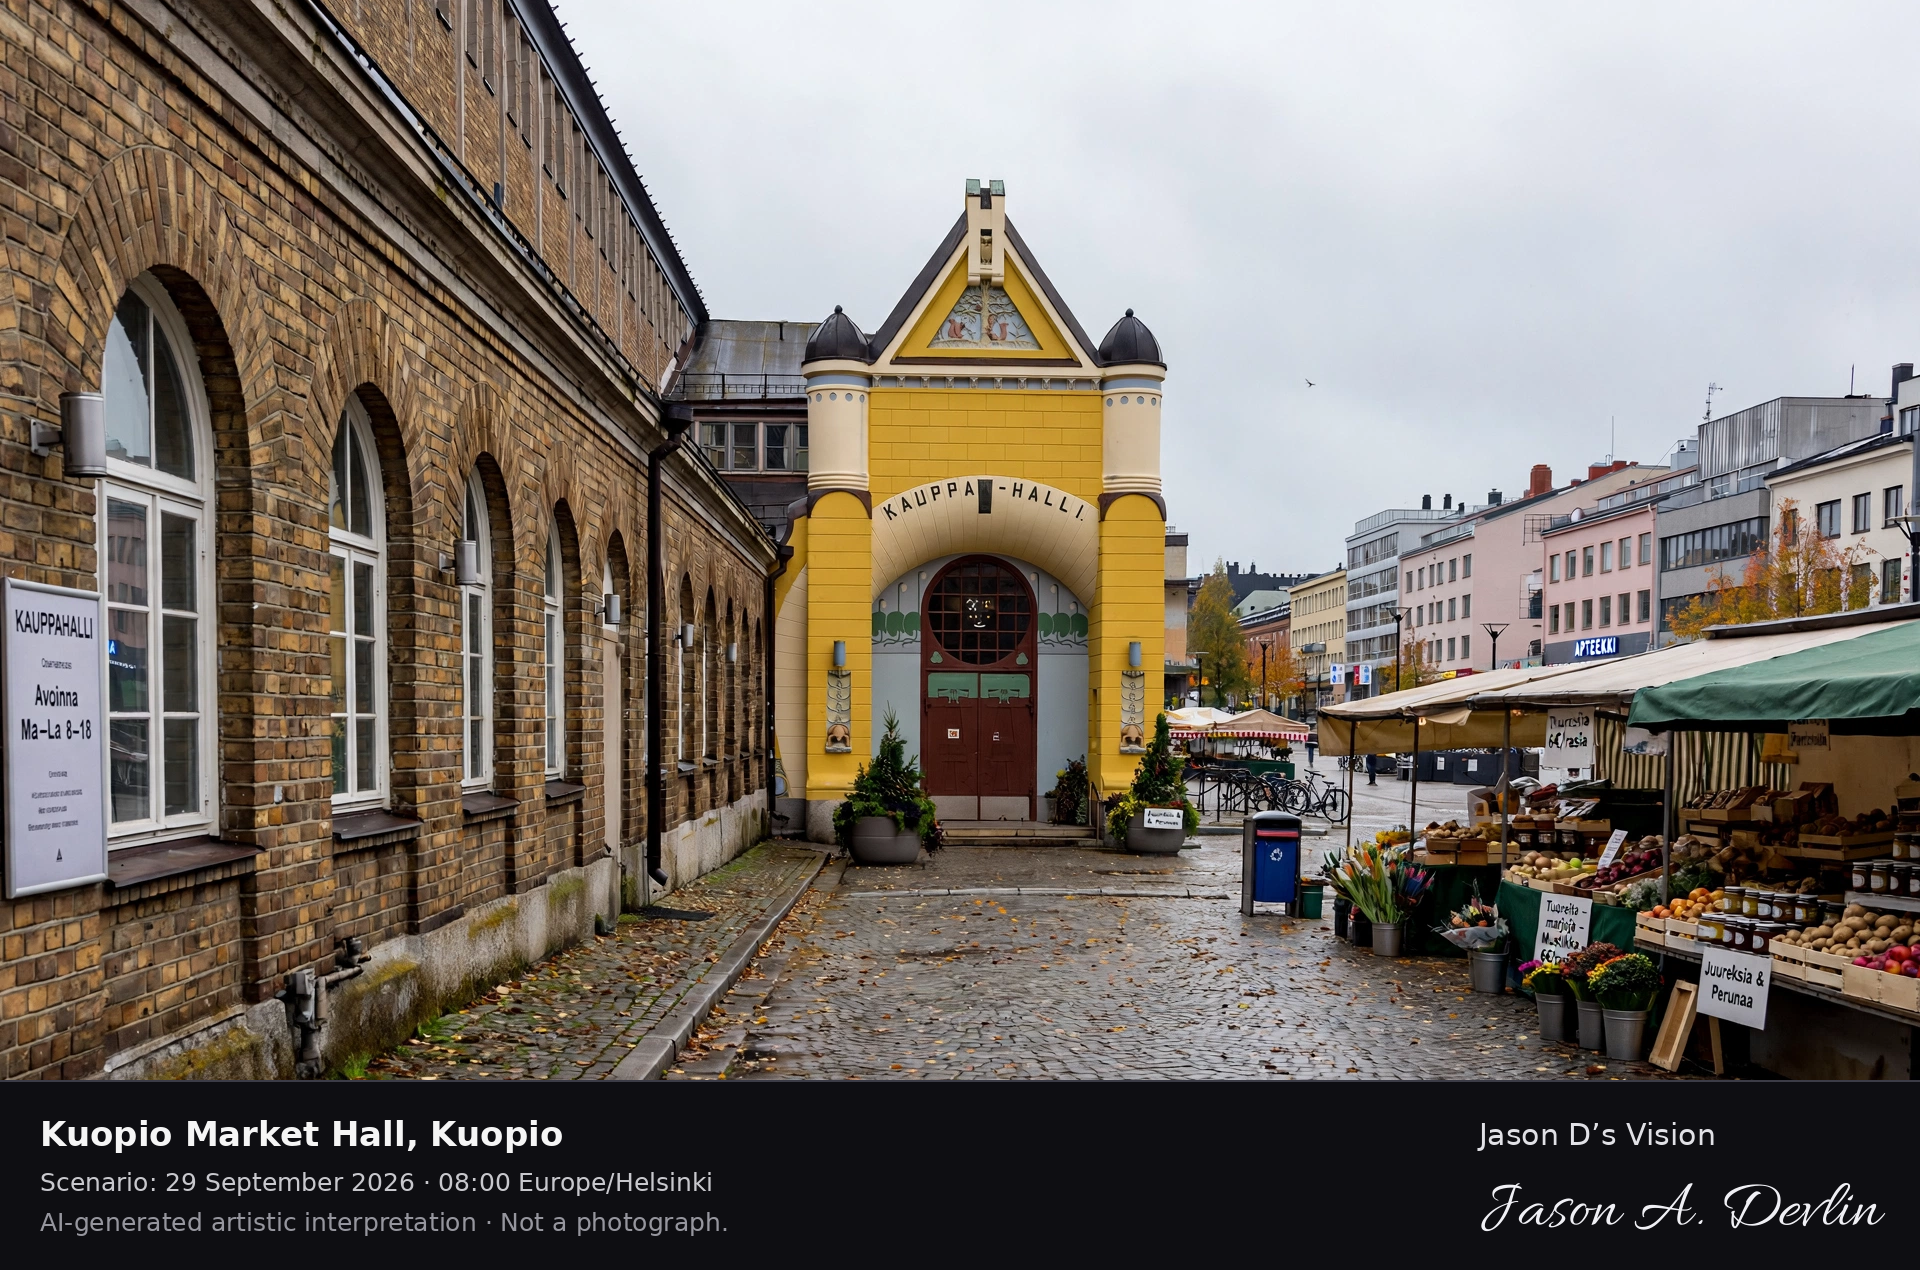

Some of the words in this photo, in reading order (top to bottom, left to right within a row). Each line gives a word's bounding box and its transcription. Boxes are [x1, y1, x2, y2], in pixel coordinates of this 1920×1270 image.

[883, 481, 975, 521] KAUPPA
[15, 609, 93, 640] KAUPPAHALLI
[1574, 636, 1616, 657] APTEEKKI
[34, 683, 79, 707] Avoinna
[1704, 961, 1753, 984] Juureksia
[1756, 970, 1765, 987] &
[1711, 984, 1753, 1008] Perunaa
